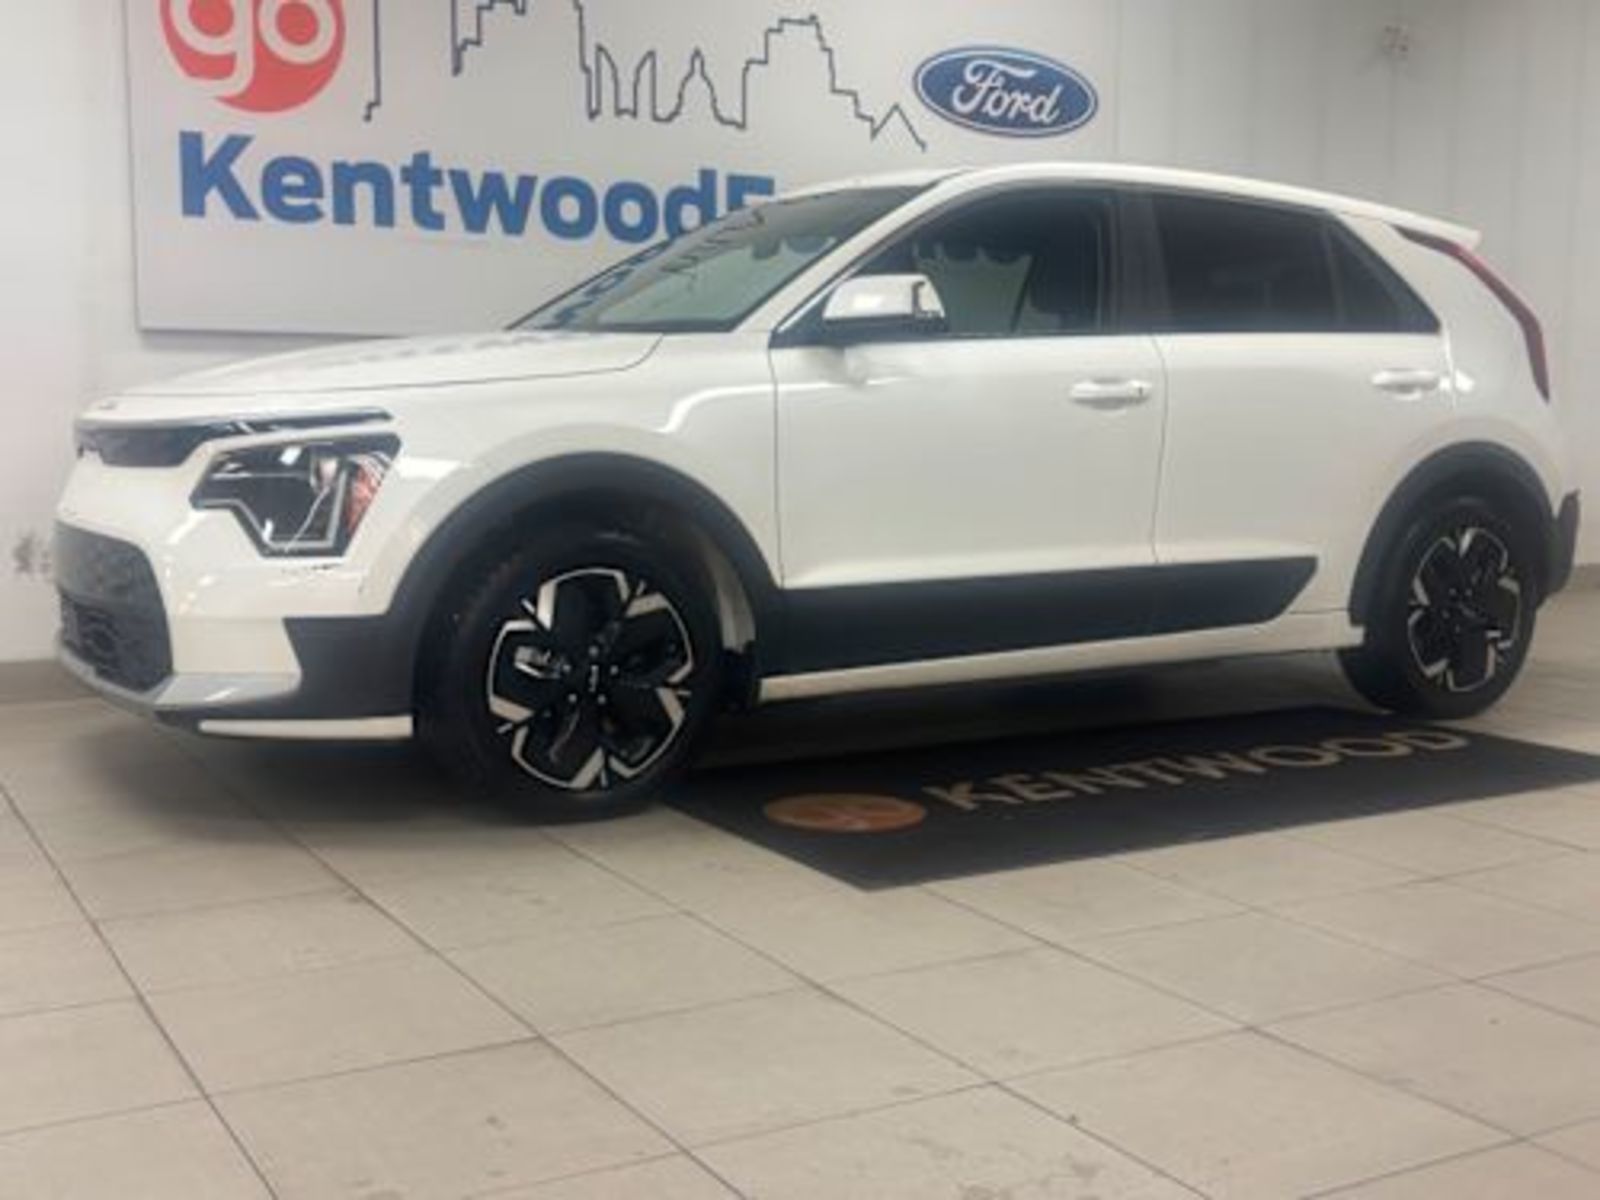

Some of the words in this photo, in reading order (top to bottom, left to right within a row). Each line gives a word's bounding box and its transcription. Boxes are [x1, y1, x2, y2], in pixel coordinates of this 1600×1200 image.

[170, 0, 336, 97] go
[953, 59, 1064, 123] Ford
[922, 730, 1470, 811] KENTWOOD
